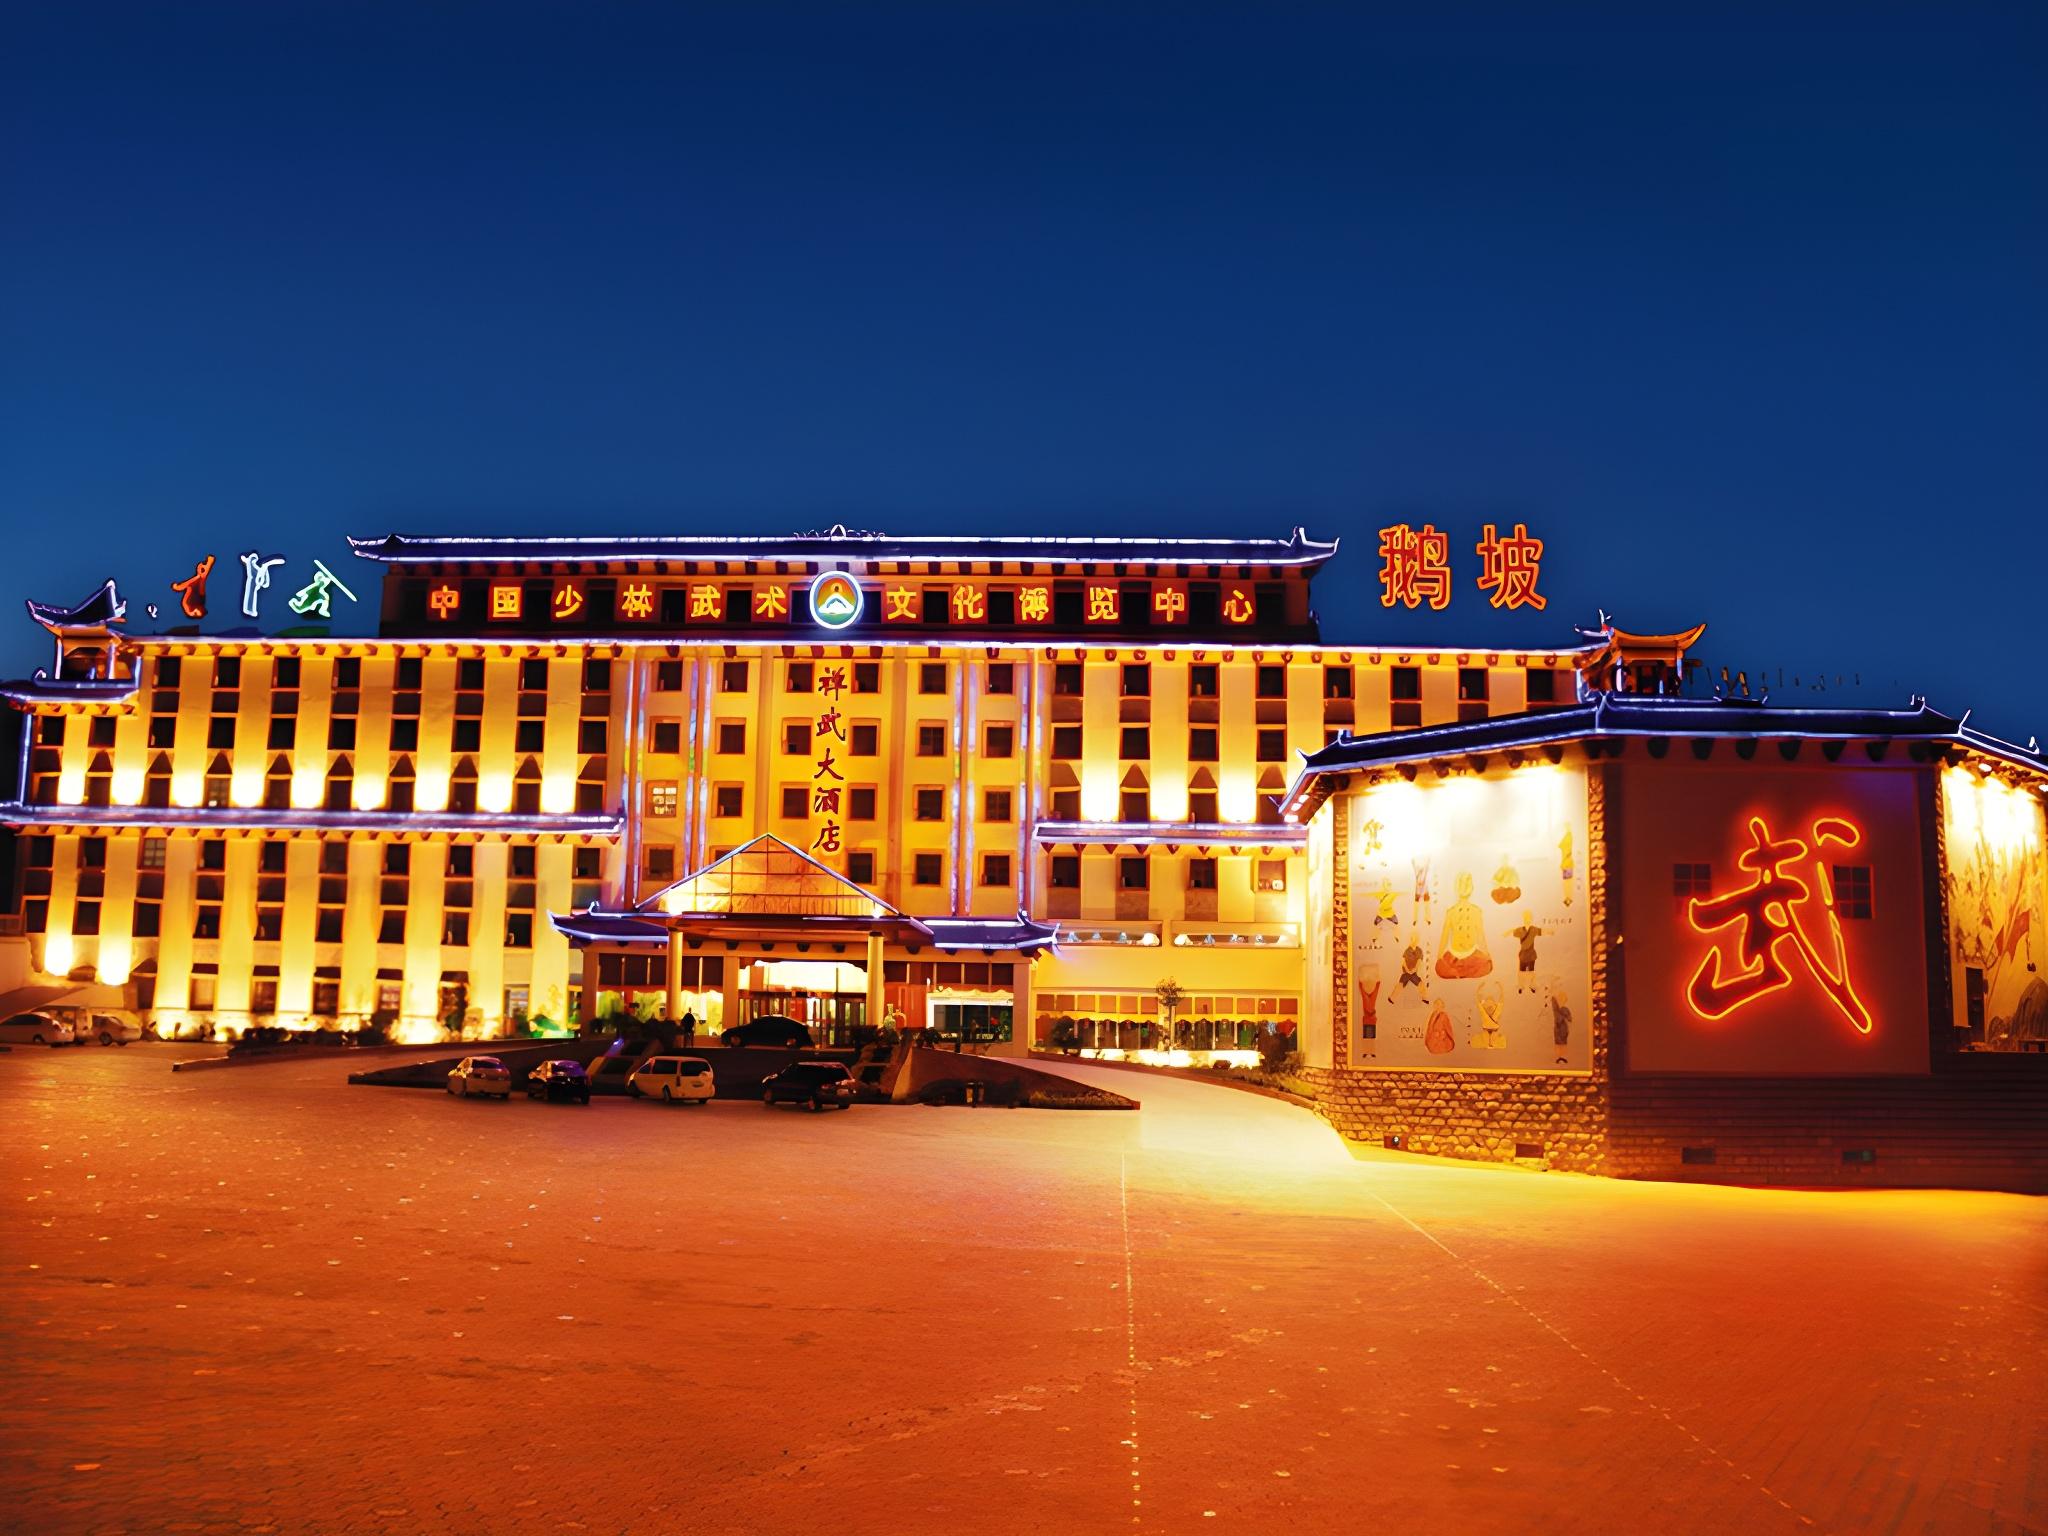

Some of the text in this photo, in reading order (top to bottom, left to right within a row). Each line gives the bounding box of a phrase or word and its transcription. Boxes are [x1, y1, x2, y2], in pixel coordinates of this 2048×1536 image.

[430, 583, 1254, 623] 中国少林武术 文化博览中心
[1378, 523, 1548, 611] 鹅坡
[1686, 815, 1873, 1034] 武
